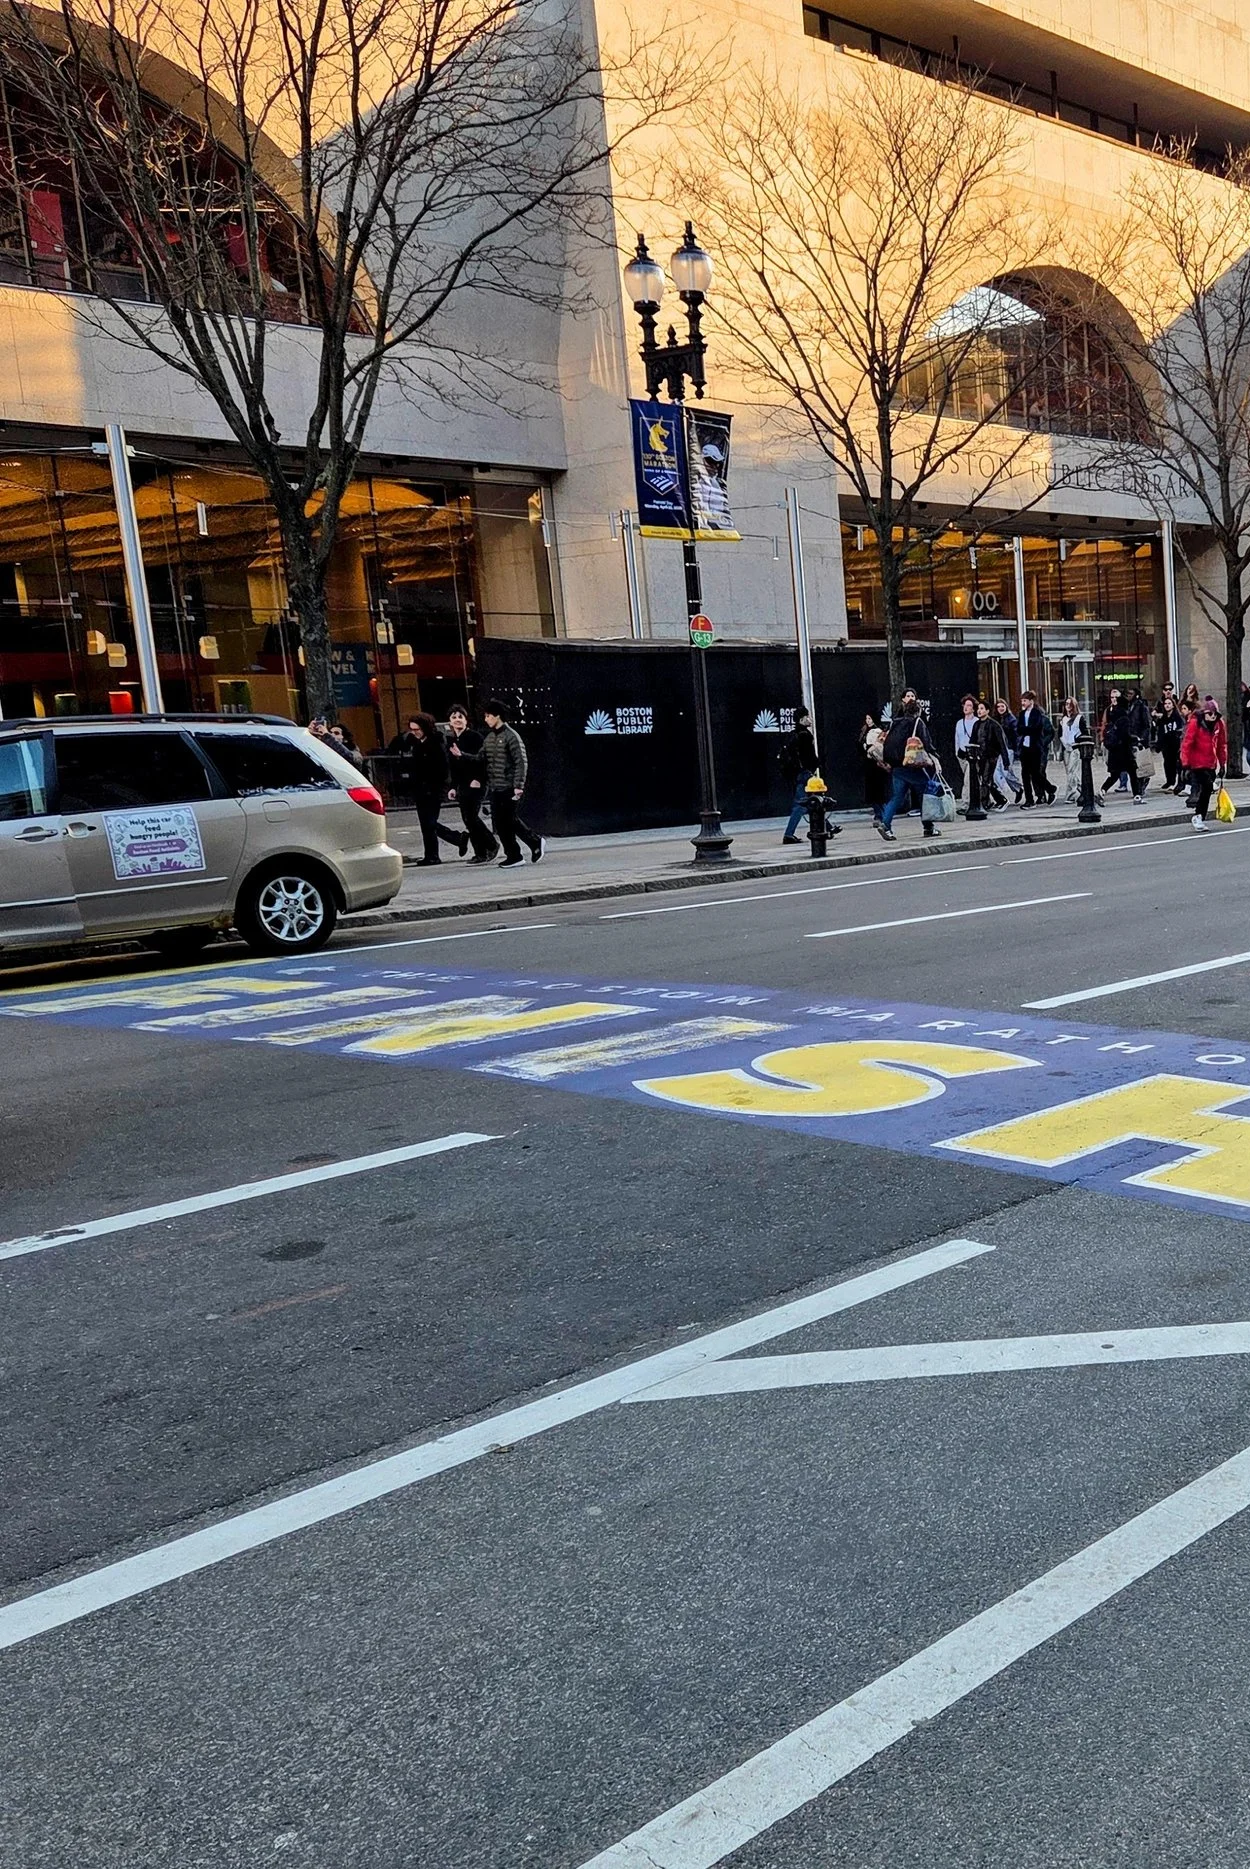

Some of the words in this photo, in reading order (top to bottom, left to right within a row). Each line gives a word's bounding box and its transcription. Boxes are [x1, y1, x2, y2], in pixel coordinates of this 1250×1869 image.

[697, 616, 705, 630] F
[694, 632, 711, 643] G-13
[616, 707, 653, 717] BOSTON
[616, 716, 653, 726] PUBLIC
[617, 725, 653, 735] LIBRARY
[129, 818, 146, 826] Help
[144, 824, 161, 832] feed
[154, 830, 178, 840] people!
